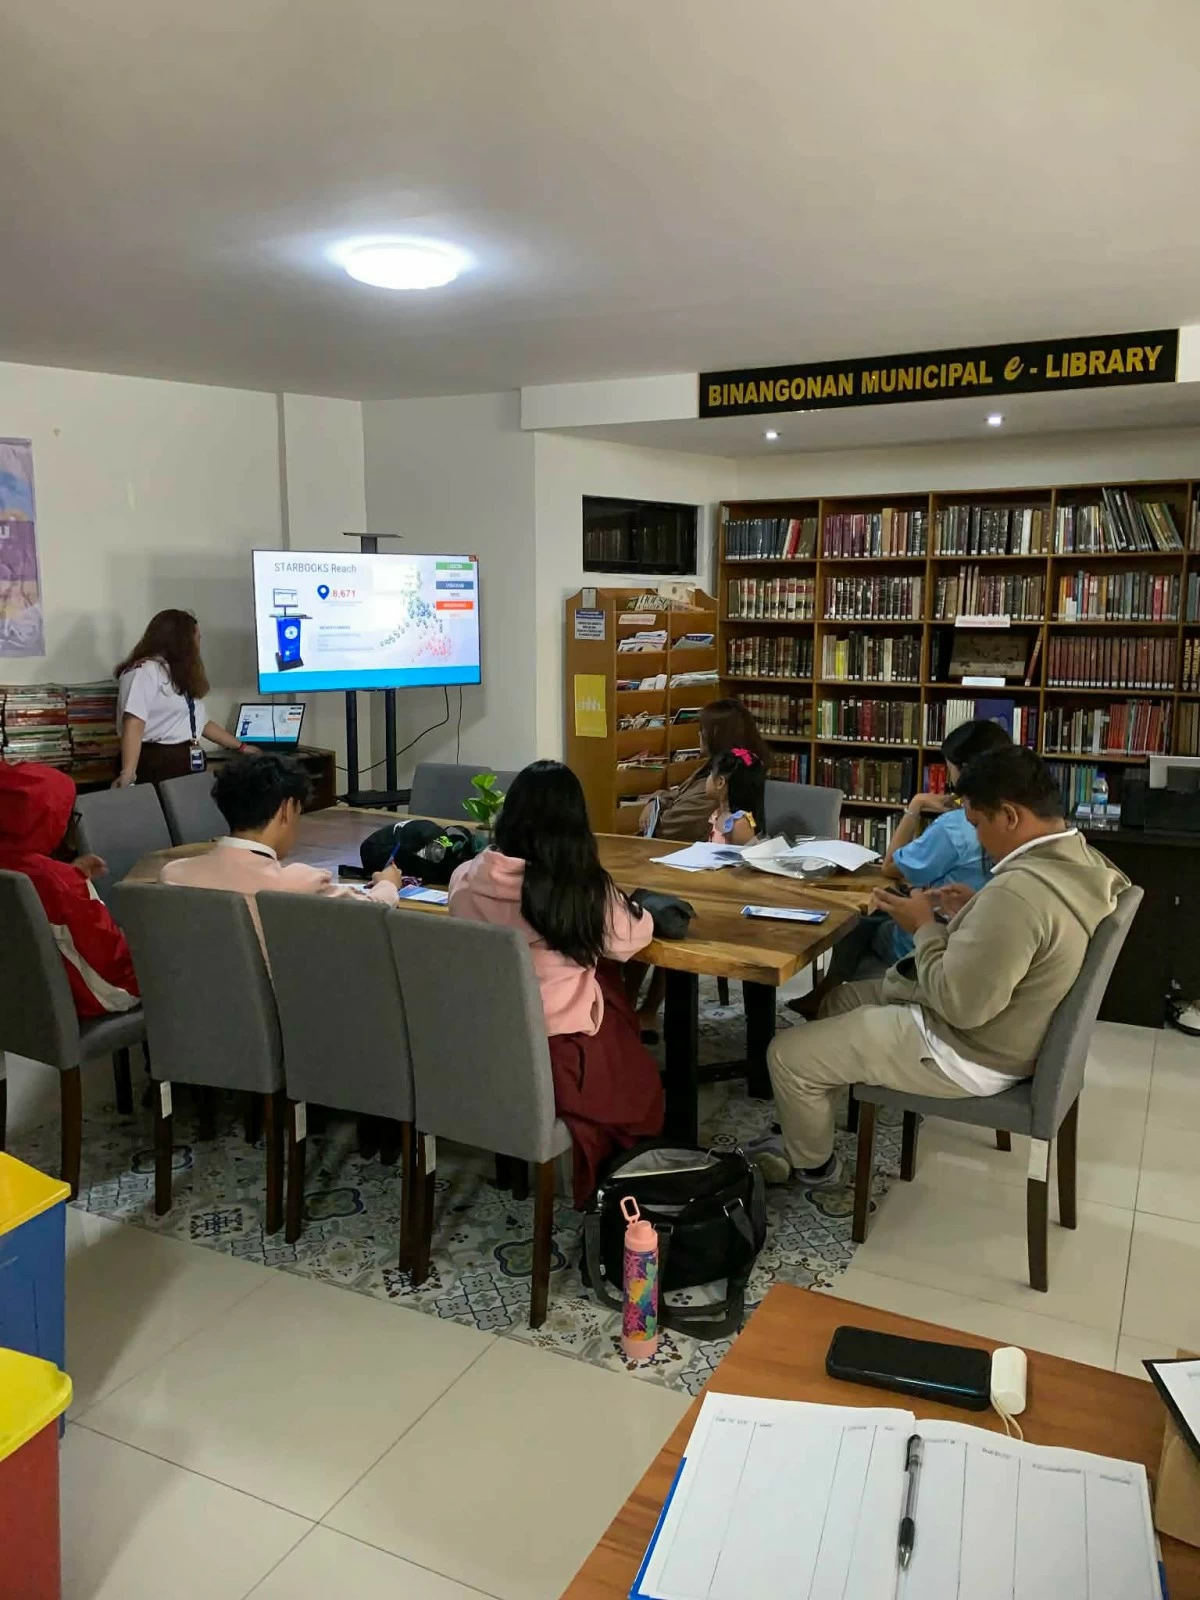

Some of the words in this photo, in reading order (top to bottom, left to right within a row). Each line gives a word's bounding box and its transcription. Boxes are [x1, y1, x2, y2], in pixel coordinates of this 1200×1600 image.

[708, 374, 853, 406] BINANGONAN
[861, 362, 993, 393] MUNICIPAL
[1046, 345, 1163, 378] LIBRARY
[274, 562, 329, 573] STARBOOKS
[331, 563, 357, 573] Reach
